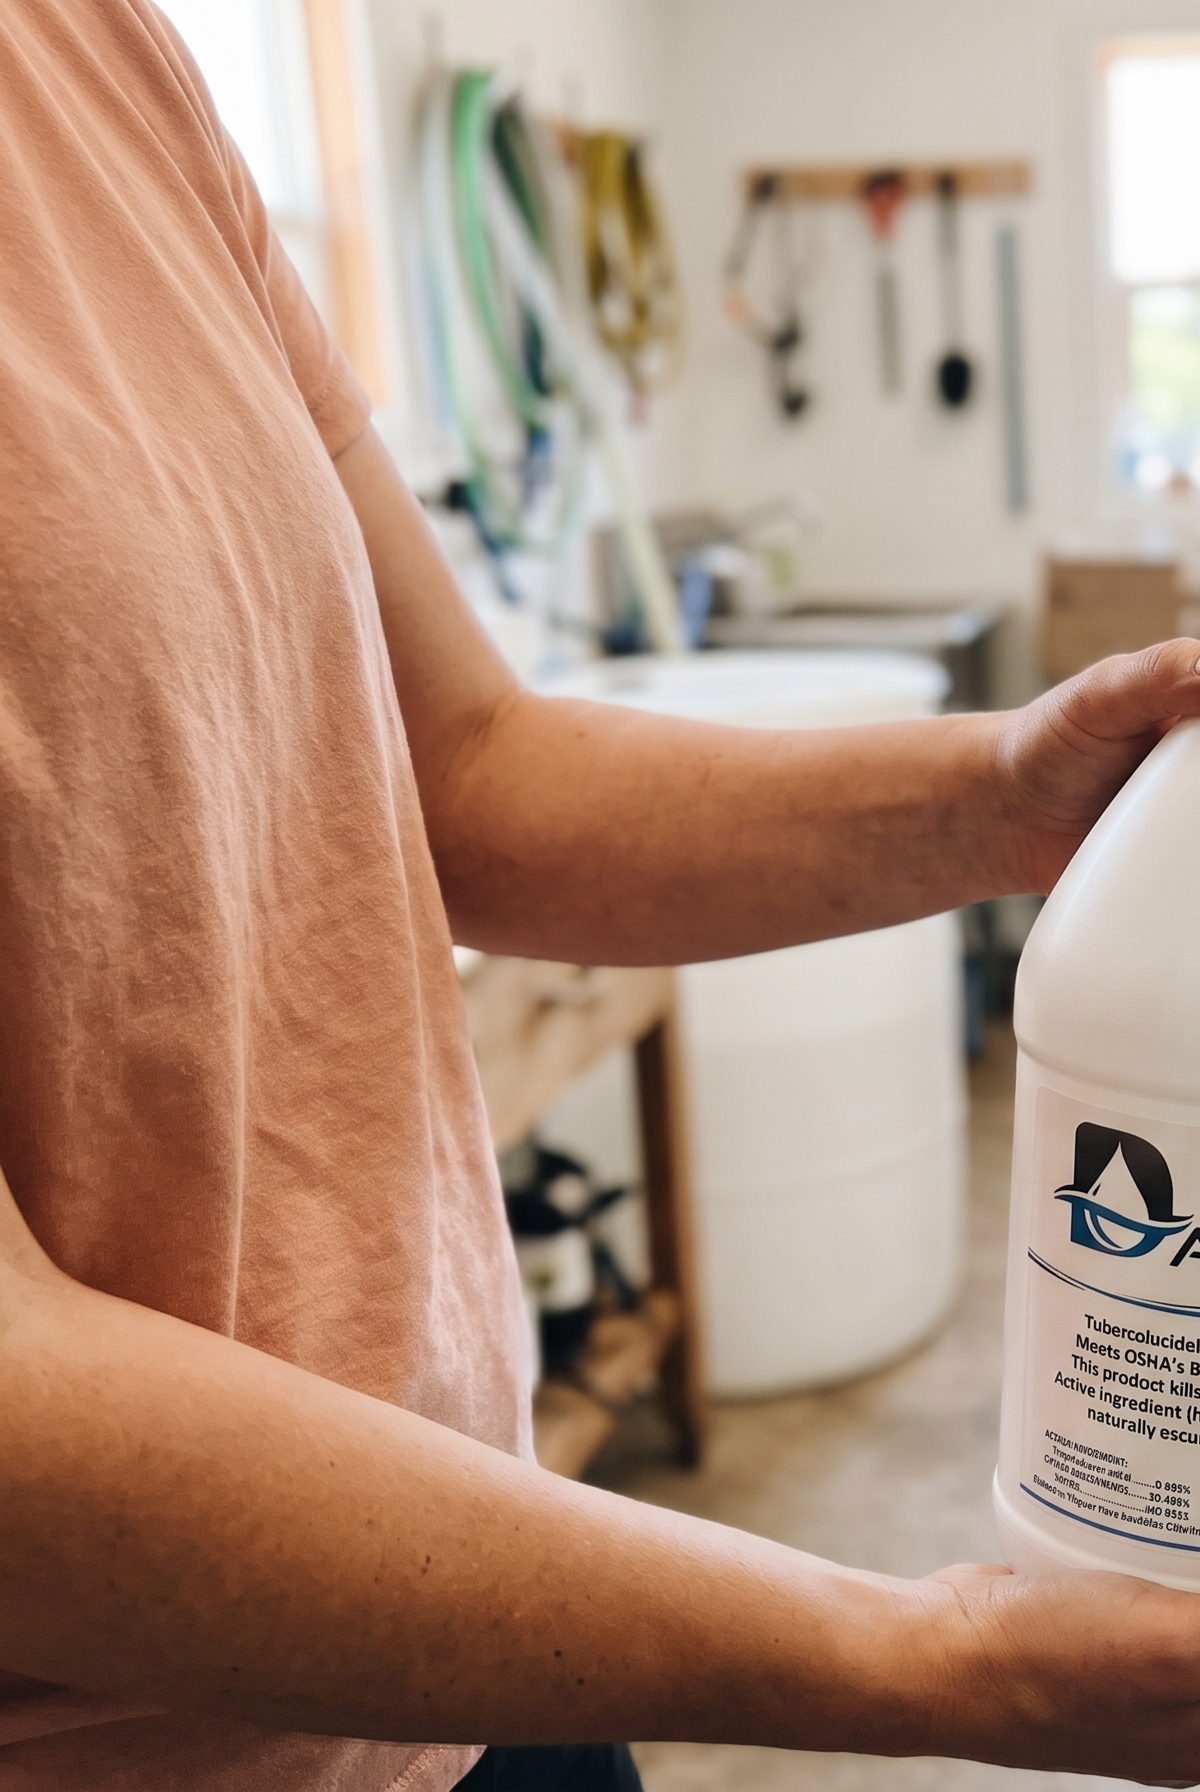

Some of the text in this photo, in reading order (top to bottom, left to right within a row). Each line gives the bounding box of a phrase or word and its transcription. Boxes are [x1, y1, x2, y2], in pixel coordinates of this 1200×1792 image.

[1076, 1334, 1120, 1360] Meets
[1072, 1354, 1099, 1377] This
[1054, 1371, 1096, 1398] Active
[1099, 1386, 1182, 1420] ingredient
[1087, 1407, 1156, 1440] naturally
